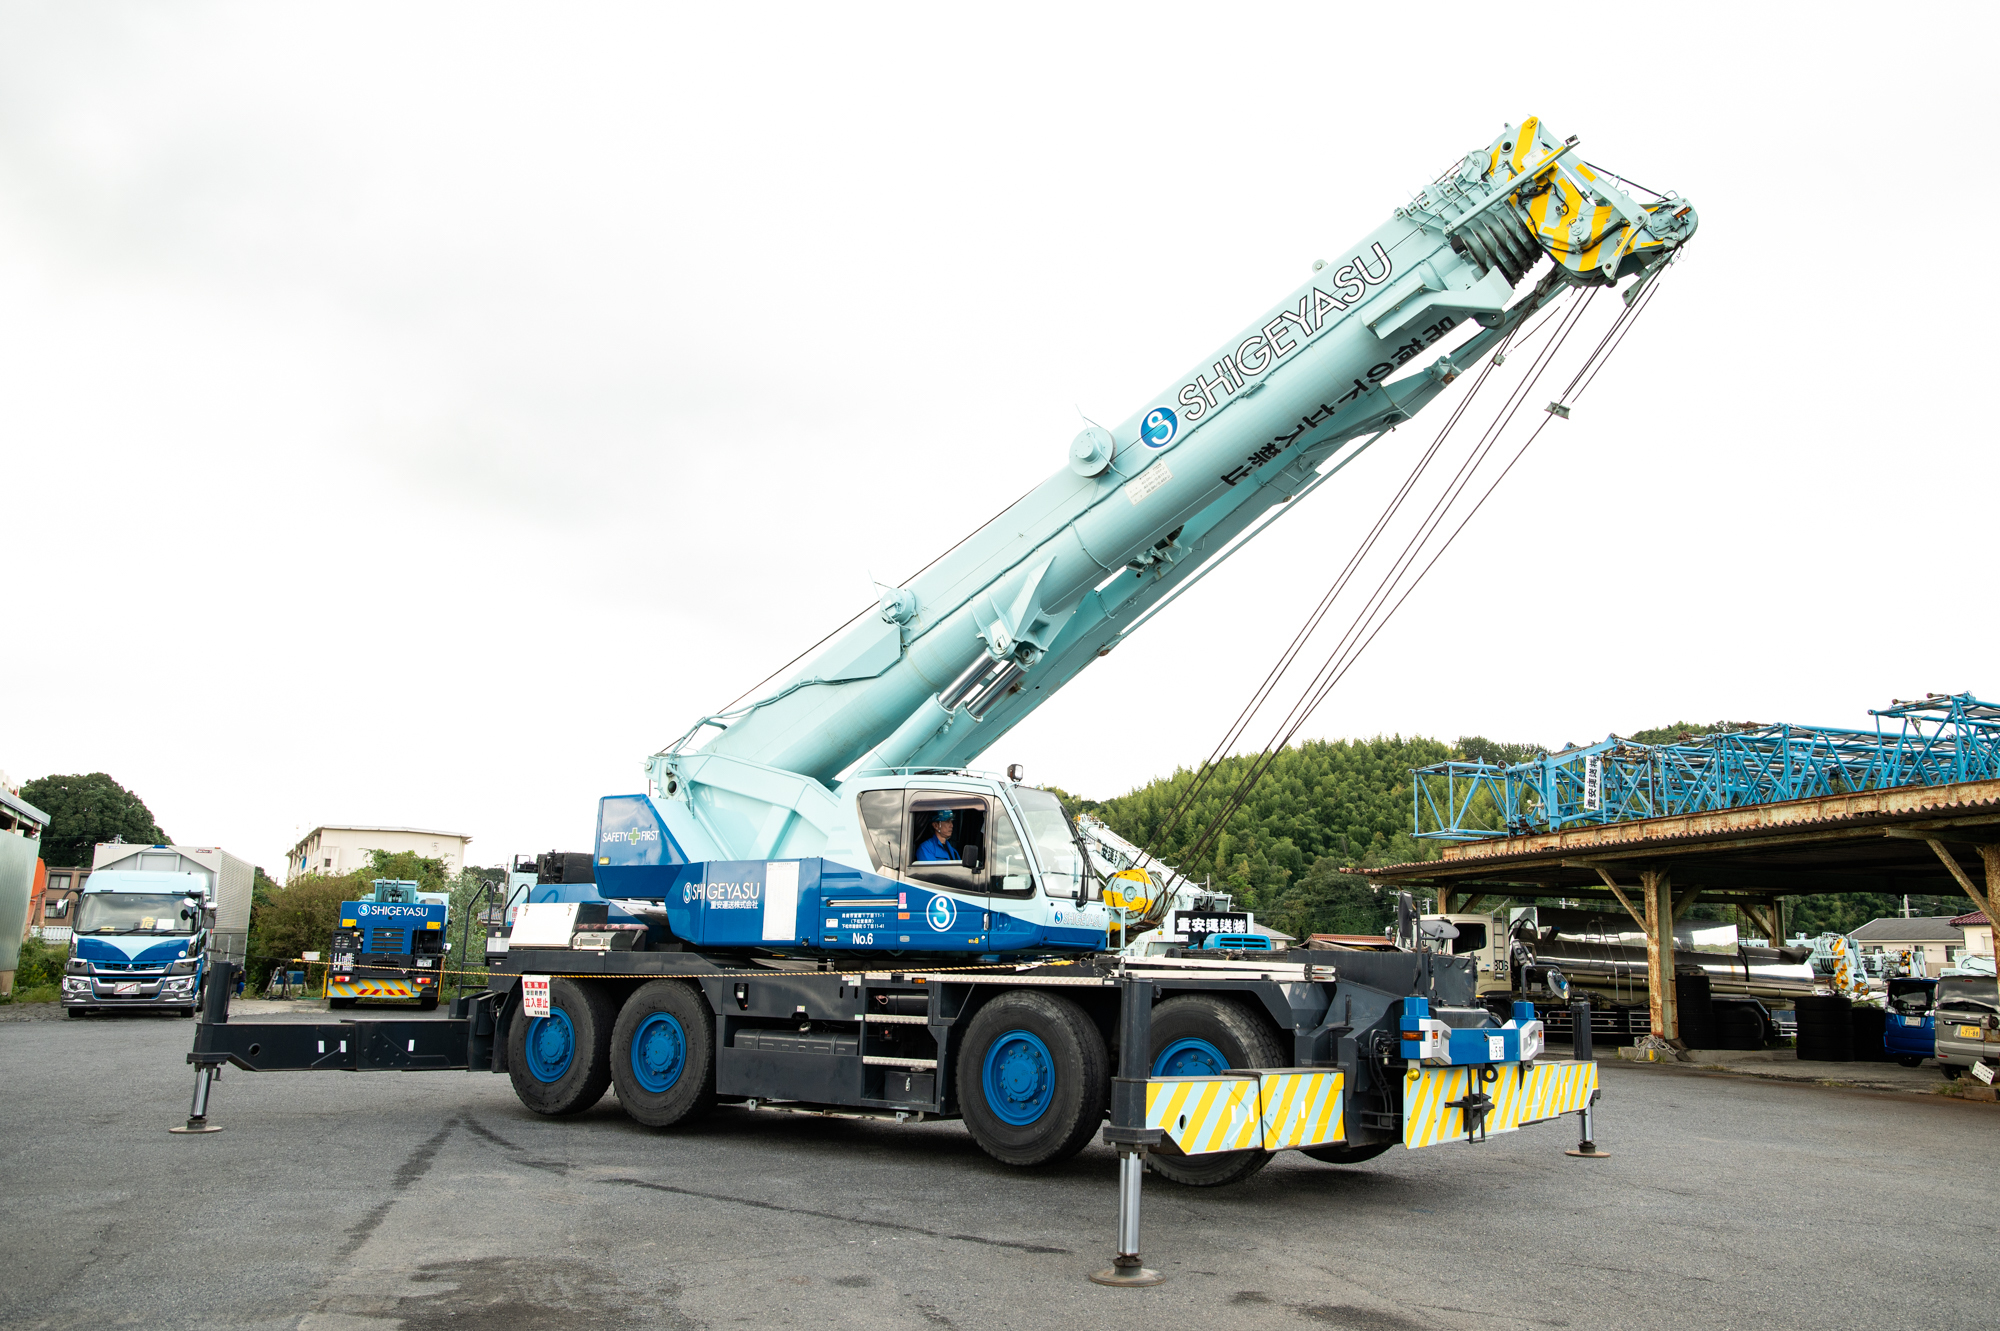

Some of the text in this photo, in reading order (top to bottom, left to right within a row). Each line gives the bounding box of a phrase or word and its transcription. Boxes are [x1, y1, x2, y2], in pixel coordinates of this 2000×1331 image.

[1178, 241, 1392, 421] SHIGEYASU
[1220, 316, 1456, 486] 吊荷の下立入禁止
[602, 830, 659, 842] SAFETY FIRST
[692, 882, 760, 900] SHIGEYASU
[371, 905, 429, 917] SHIGEYASU
[710, 900, 758, 910] 重安運送株式会社
[140, 916, 156, 929] 危
[1063, 911, 1104, 927] SHIGEYASU
[852, 932, 874, 945] No.6
[525, 998, 548, 1008] 立入禁止
